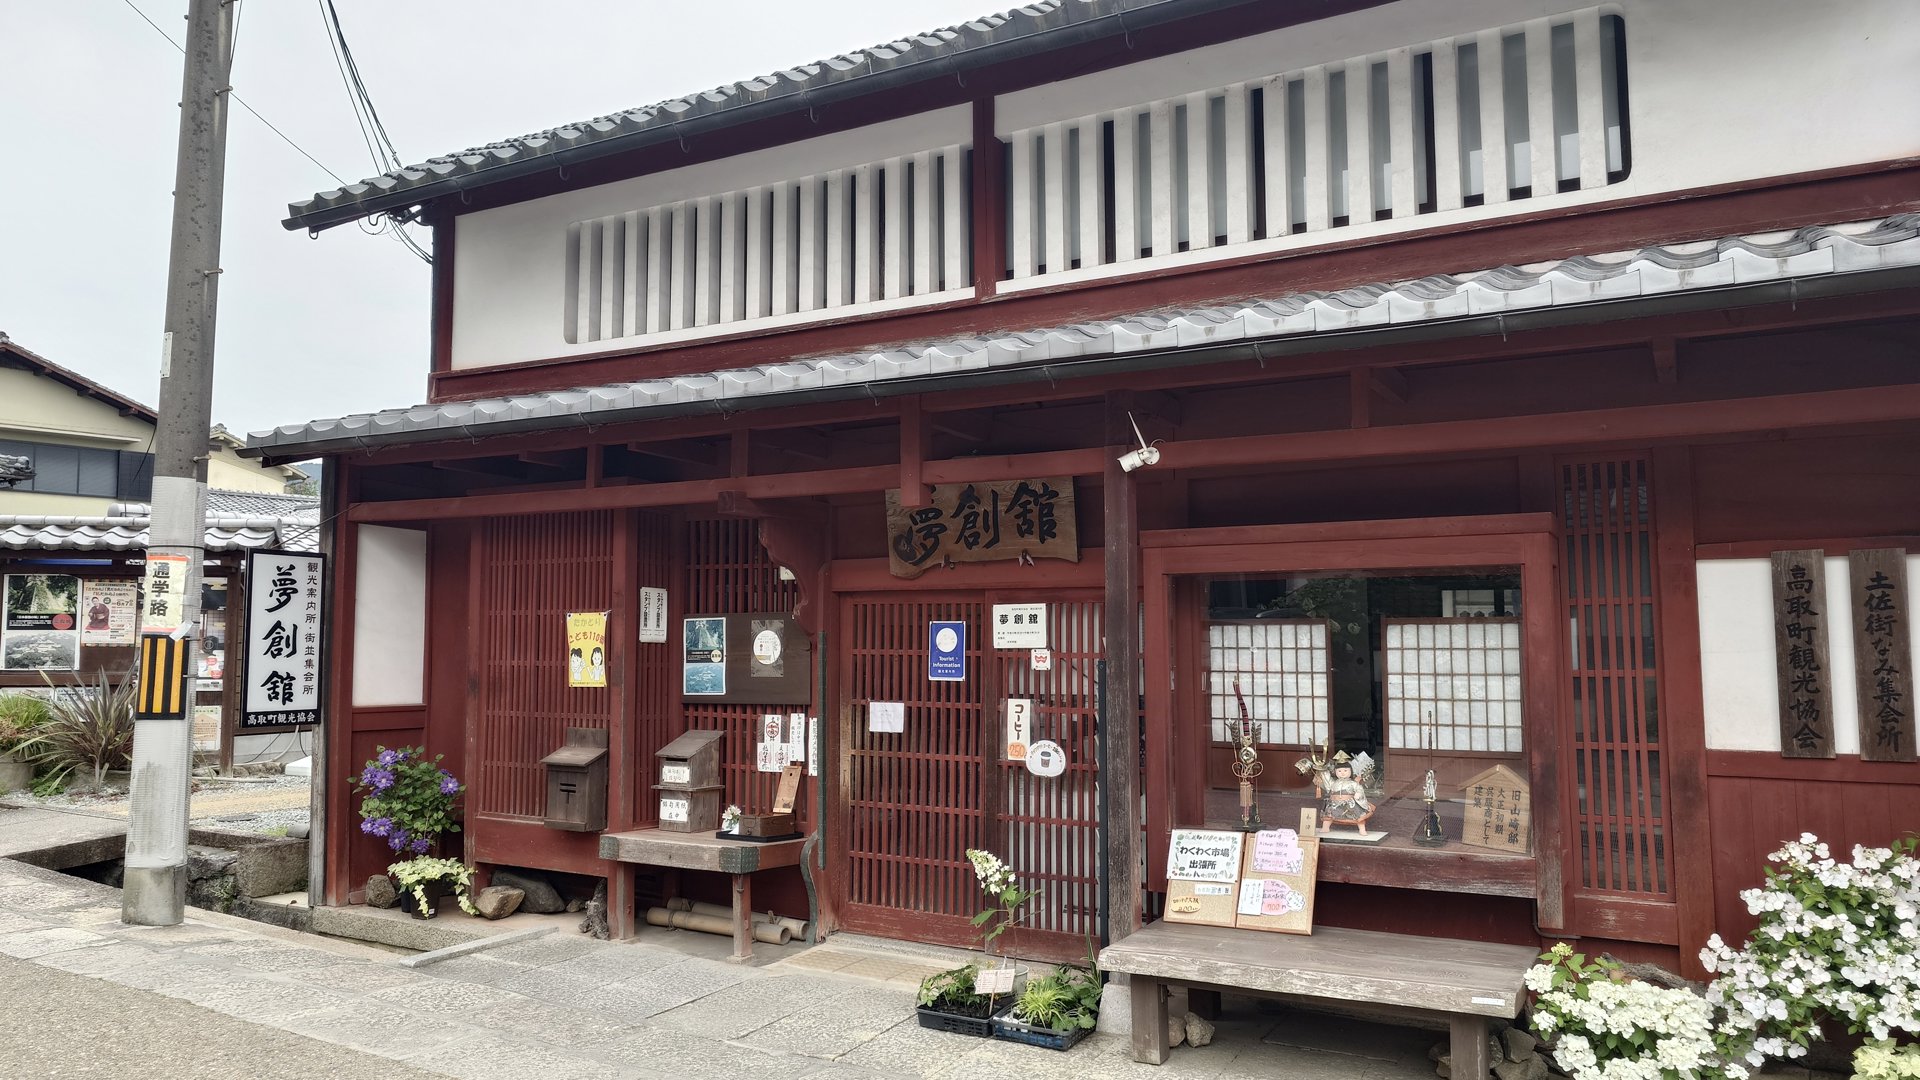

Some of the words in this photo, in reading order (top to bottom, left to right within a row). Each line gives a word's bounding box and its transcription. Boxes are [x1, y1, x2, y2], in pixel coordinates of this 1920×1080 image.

[149, 561, 170, 617] 通学路
[302, 562, 318, 695] 観光案内所・街並集会所
[574, 618, 601, 627] たかとり
[1783, 564, 1824, 749] 高取町観光協会
[1863, 571, 1906, 753] 土佐街なみ集会所
[247, 712, 316, 726] 高取町観光協会
[1014, 704, 1024, 740] コーヒー
[1495, 787, 1506, 835] 大正初期
[1508, 790, 1522, 844] 旧山崎邸
[1179, 846, 1230, 857] わくわく市場
[1189, 859, 1217, 870] 出張所
